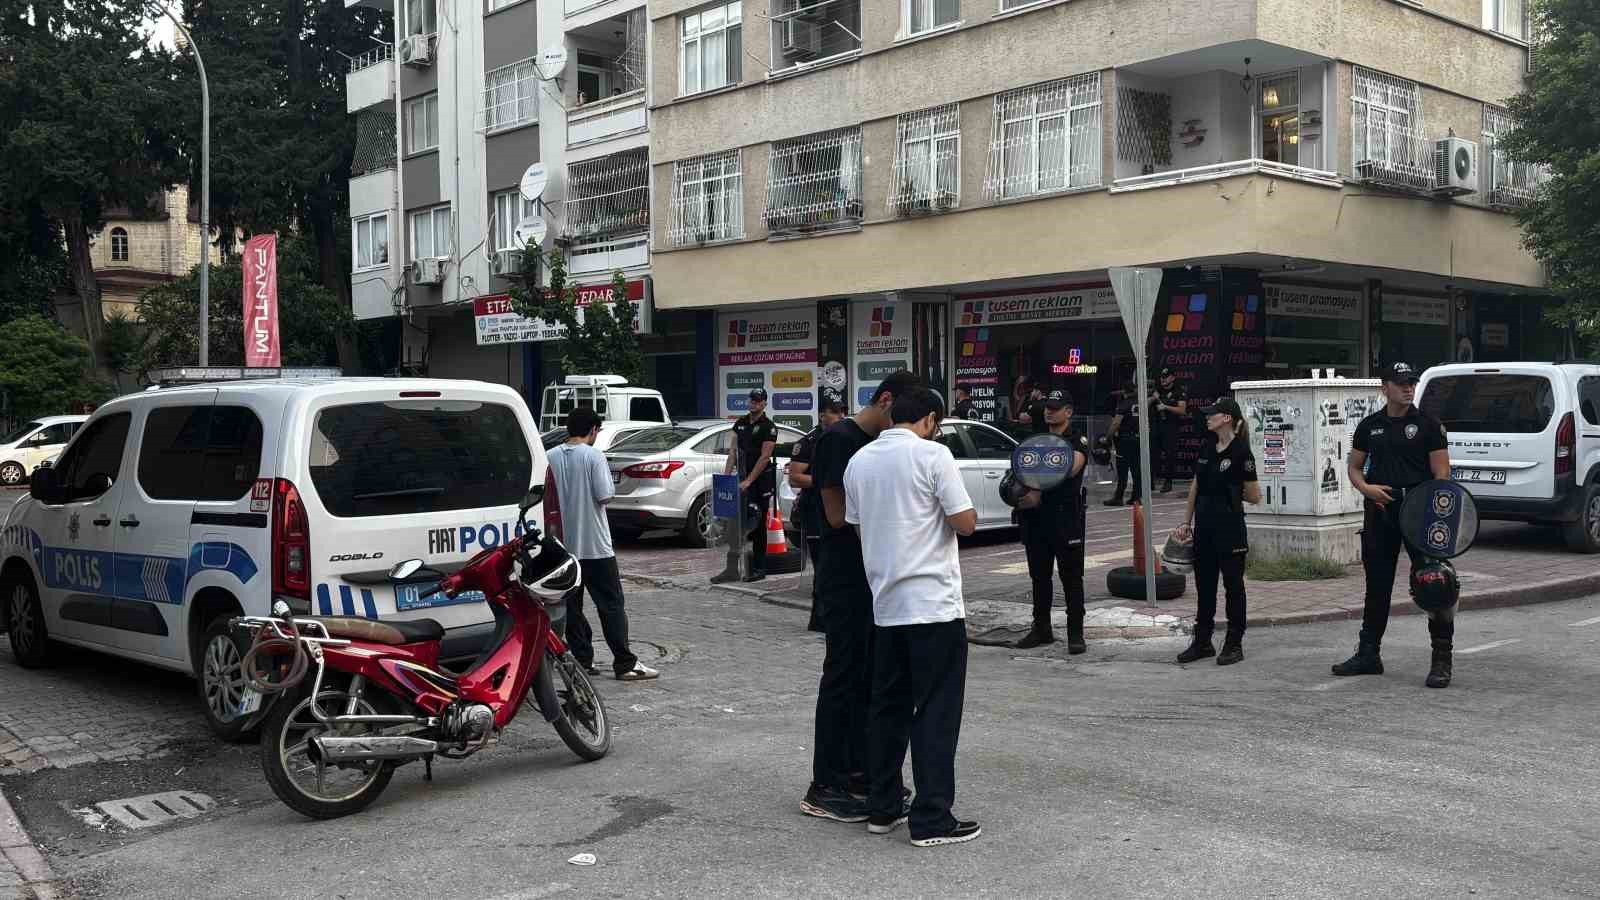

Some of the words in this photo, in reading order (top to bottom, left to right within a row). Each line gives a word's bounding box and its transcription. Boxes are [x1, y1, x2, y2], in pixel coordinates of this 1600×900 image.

[254, 248, 270, 353] PANTUM
[988, 298, 1030, 313] tusem
[1032, 294, 1082, 309] reklam
[1280, 292, 1308, 304] tusem
[749, 321, 776, 334] tusem
[777, 319, 810, 332] reklam
[482, 334, 501, 343] PLOTTER
[521, 331, 538, 340] LAPTOP
[857, 339, 881, 348] tusem
[881, 337, 908, 348] reklam
[1162, 335, 1213, 350] tusem
[1160, 352, 1214, 365] reklam
[956, 367, 997, 376] promosyon
[1053, 364, 1074, 374] tusem
[1075, 364, 1098, 374] reklam
[1490, 471, 1504, 481] 217
[255, 480, 270, 498] 112
[429, 528, 457, 554] FIAT
[328, 552, 384, 562] DOBLO
